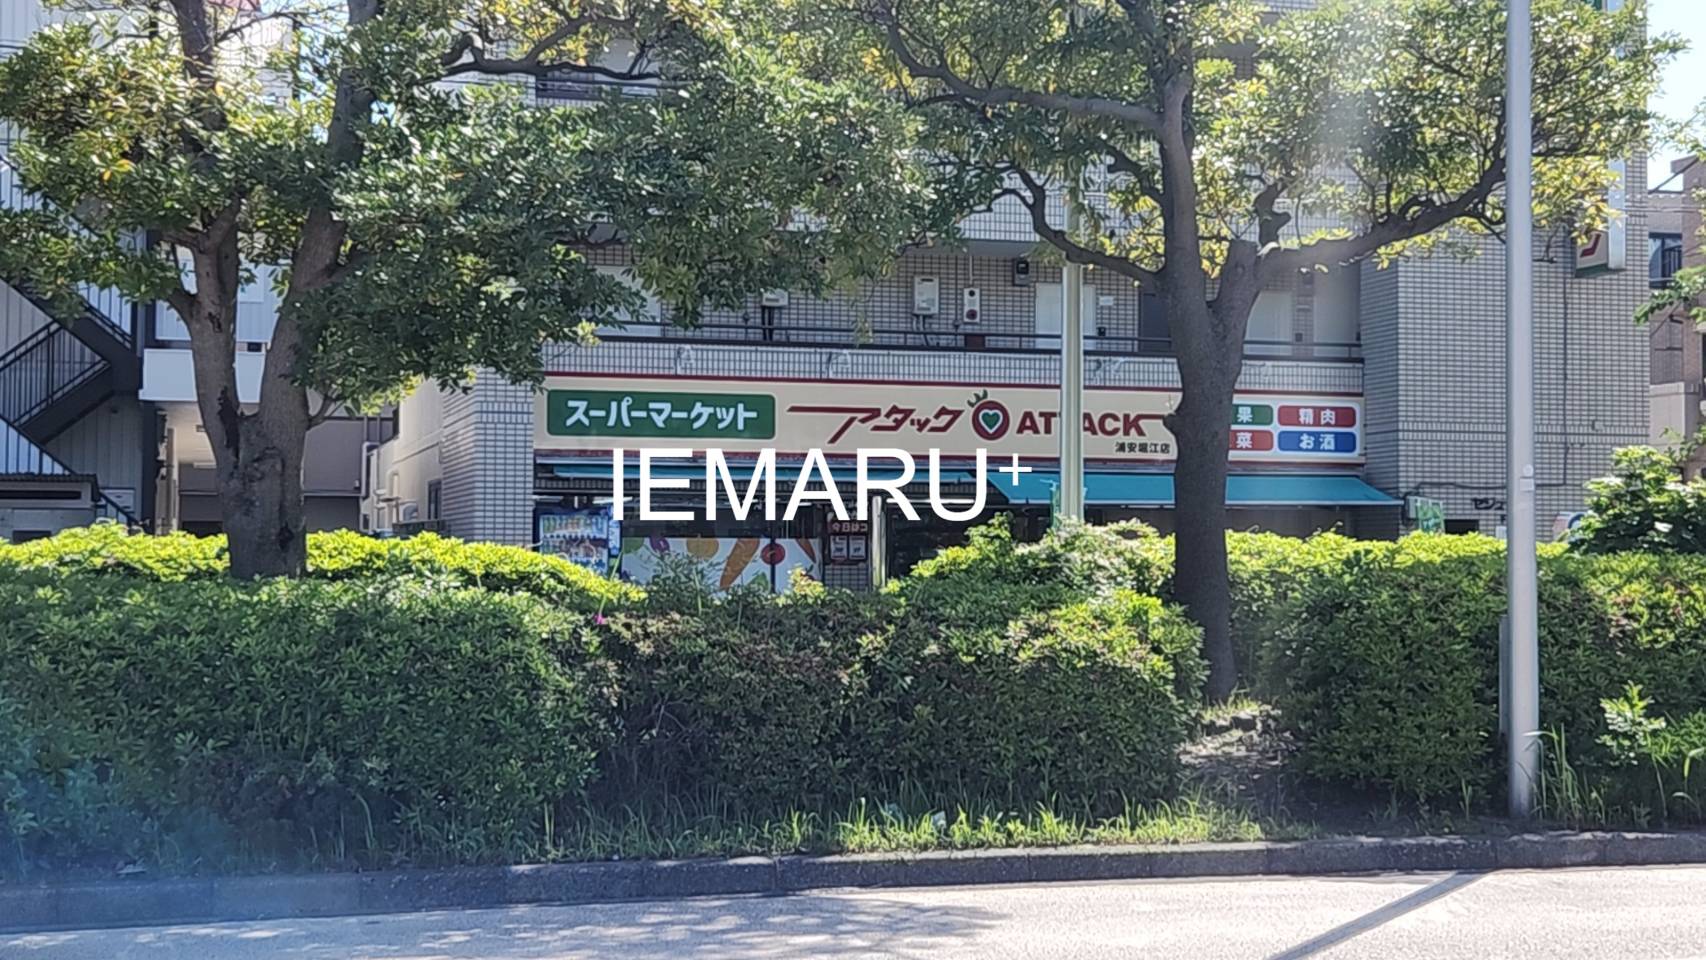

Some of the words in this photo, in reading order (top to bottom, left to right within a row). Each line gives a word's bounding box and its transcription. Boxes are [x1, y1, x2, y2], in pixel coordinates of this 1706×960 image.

[565, 396, 758, 431] スーパーマーケット
[1236, 406, 1253, 423] 果
[1298, 408, 1336, 425] 精肉
[786, 404, 966, 445] アタック
[1016, 410, 1164, 437] ATACK
[1231, 432, 1253, 449] 菜
[1299, 433, 1336, 451] お酒
